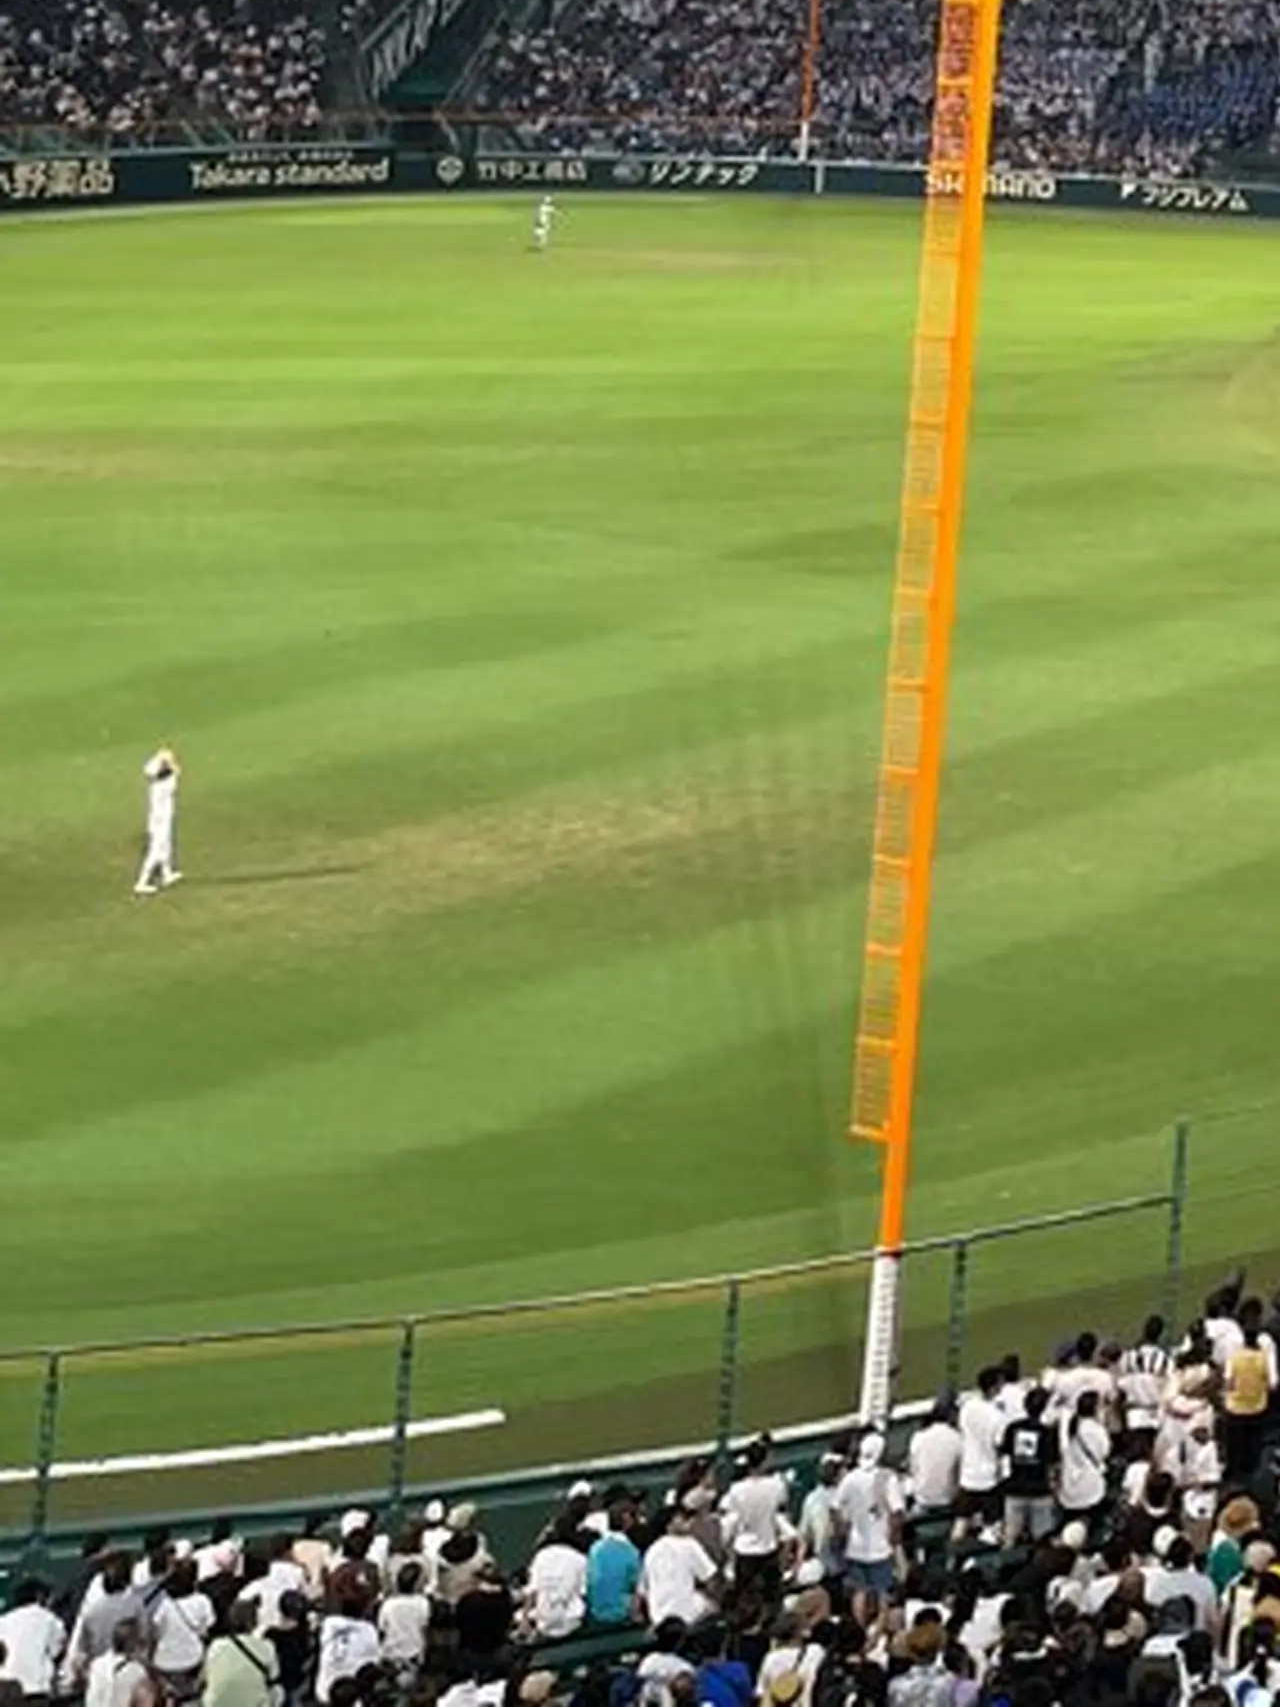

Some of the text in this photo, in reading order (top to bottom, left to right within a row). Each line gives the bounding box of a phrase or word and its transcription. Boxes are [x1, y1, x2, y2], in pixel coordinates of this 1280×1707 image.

[0, 160, 114, 198] 野薬品
[274, 157, 391, 186] standard
